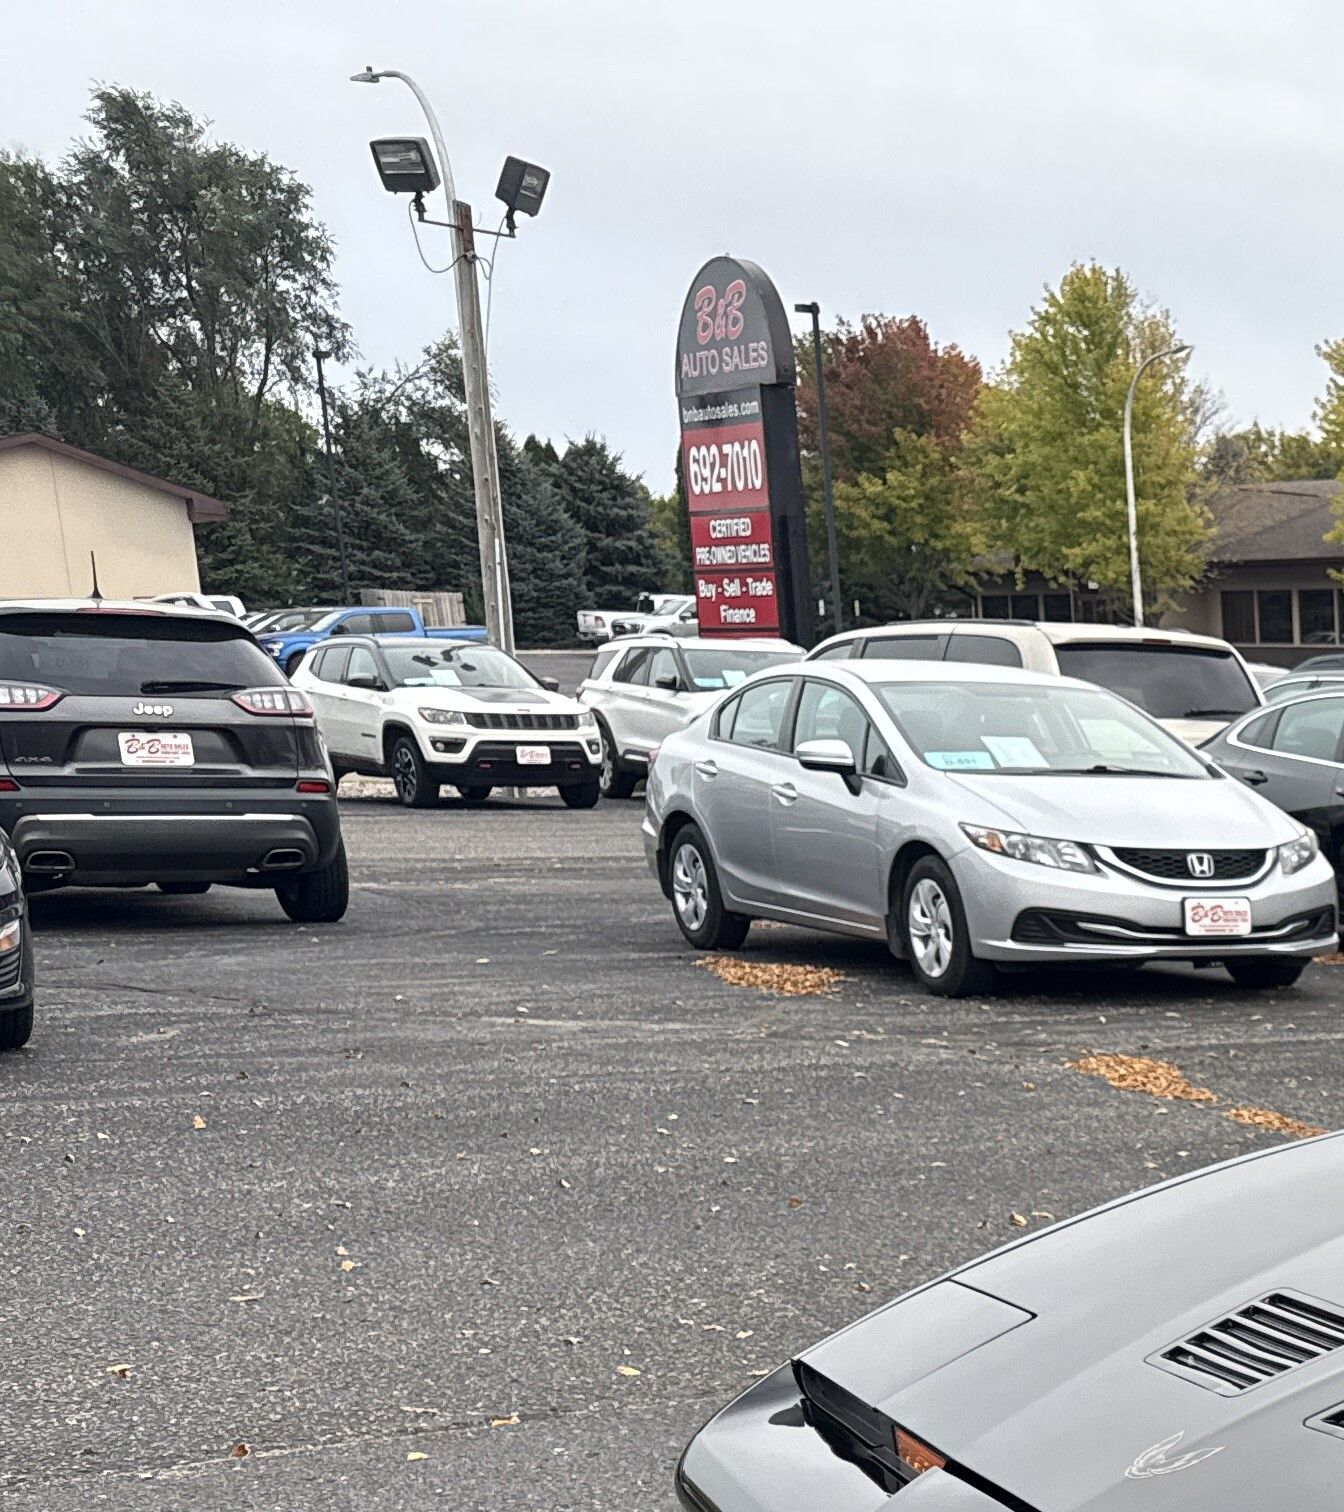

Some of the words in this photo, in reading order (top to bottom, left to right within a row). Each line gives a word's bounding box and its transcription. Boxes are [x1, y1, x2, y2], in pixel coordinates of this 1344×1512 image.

[681, 348, 719, 379] AUTO
[722, 341, 768, 373] SALES
[689, 438, 763, 495] 692-7010
[709, 517, 752, 539] CERTIFIED
[737, 543, 770, 564] VEHICLES
[698, 579, 717, 602] Buy
[722, 577, 742, 598] Sell
[746, 577, 774, 597] Trade
[720, 604, 756, 624] Finance
[132, 702, 174, 717] Jeep
